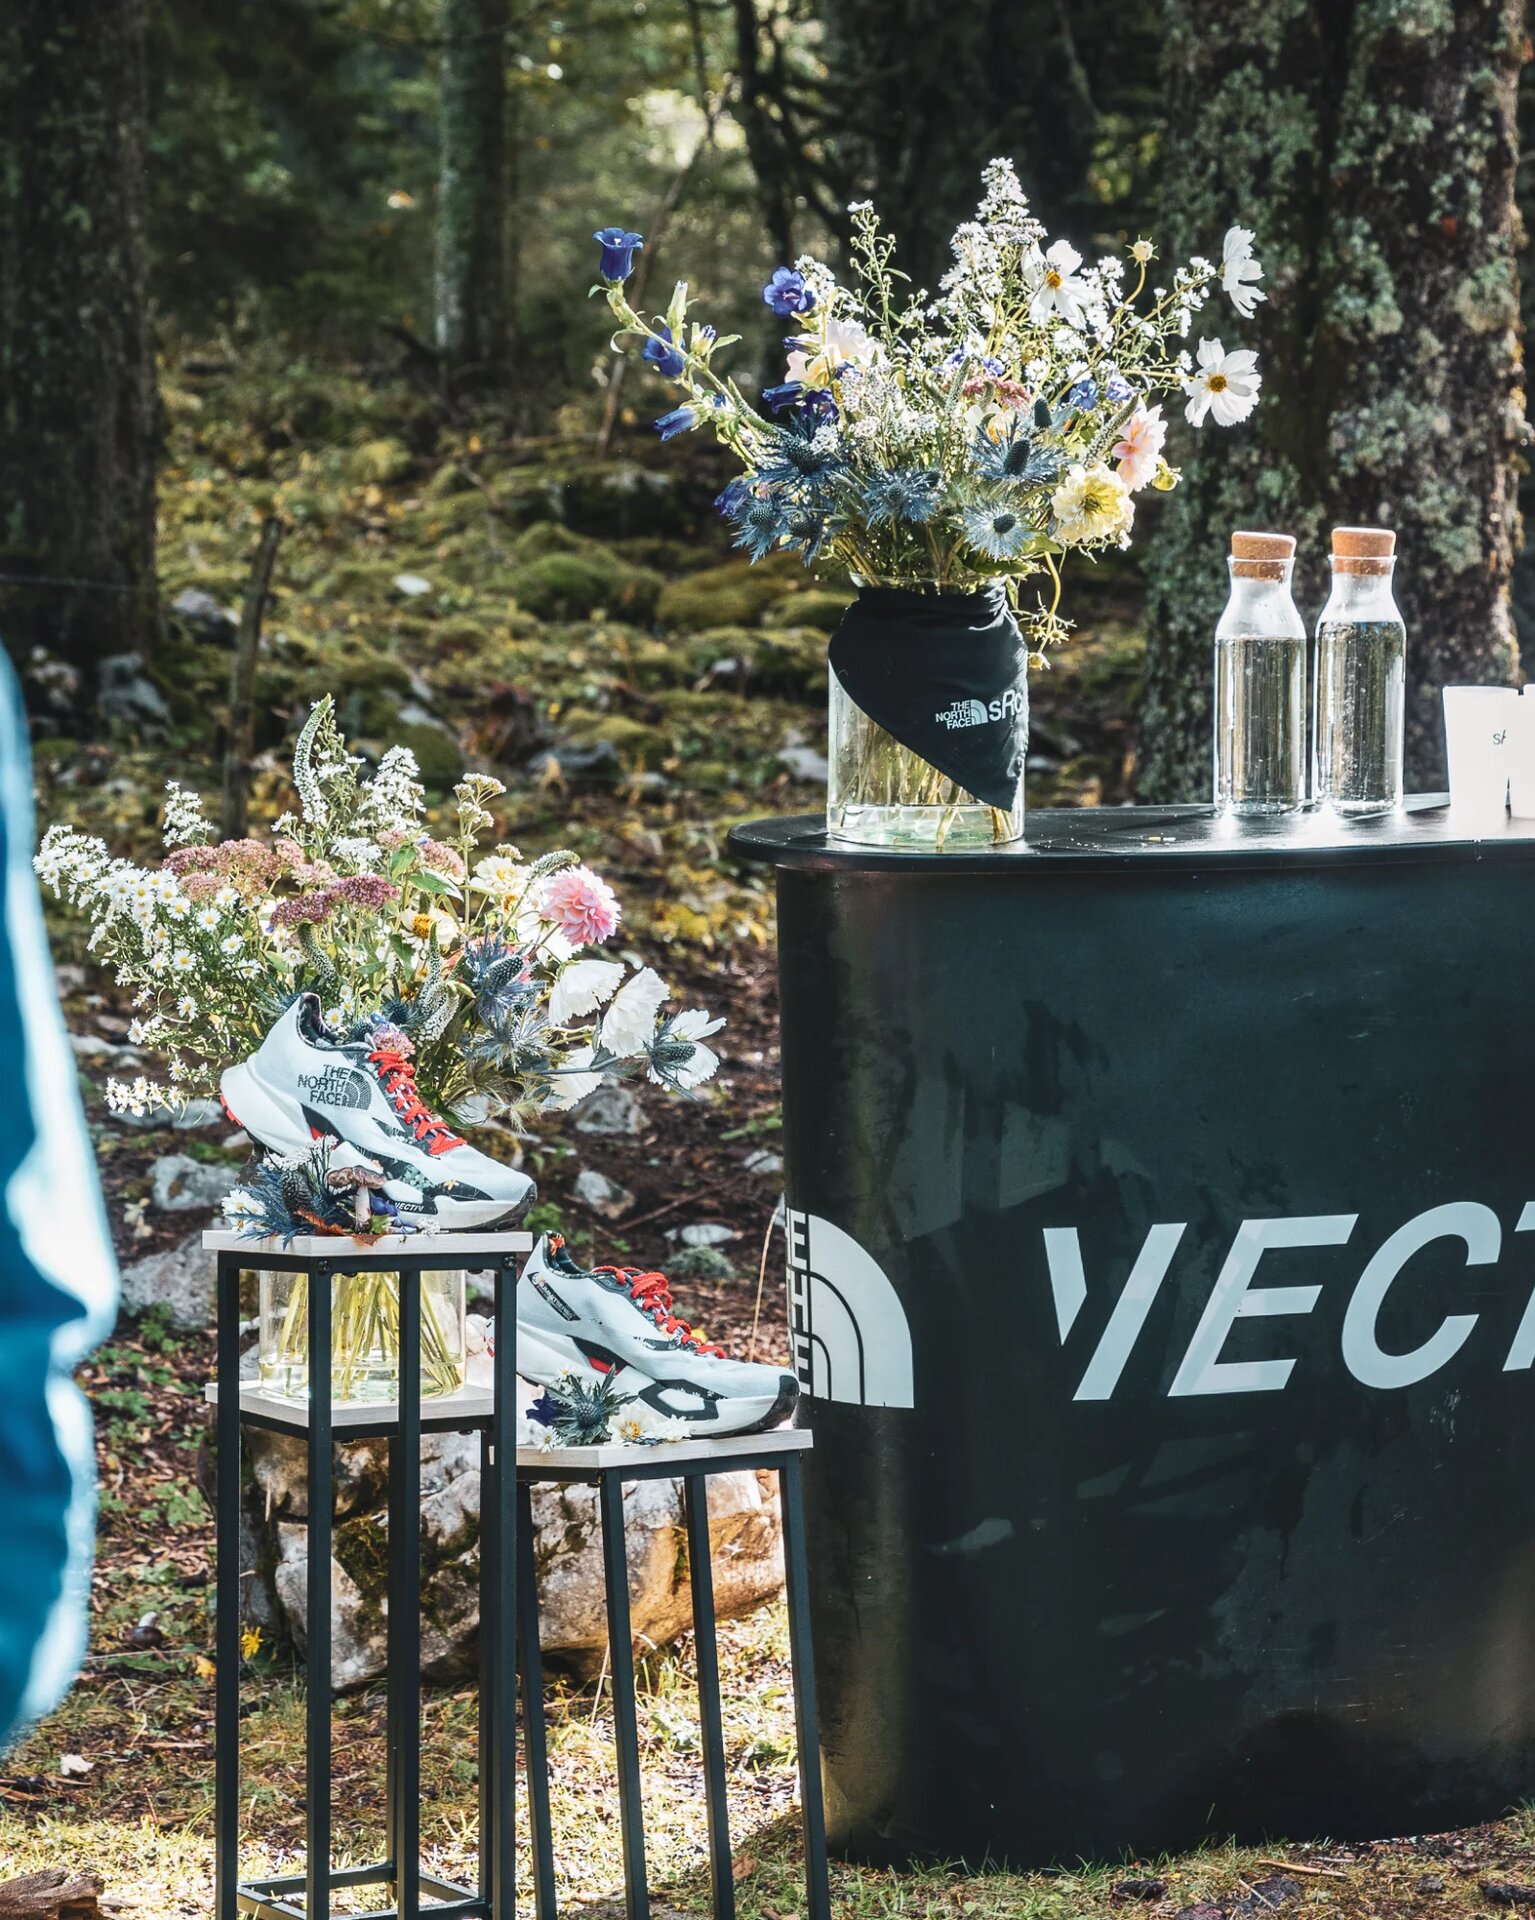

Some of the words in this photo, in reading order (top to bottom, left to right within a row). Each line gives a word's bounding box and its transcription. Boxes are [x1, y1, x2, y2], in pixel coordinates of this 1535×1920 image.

[950, 700, 970, 711] THE
[935, 708, 971, 722] NORTH
[946, 717, 972, 730] FACE
[323, 1064, 351, 1080] THE
[297, 1074, 346, 1093] NORTH
[309, 1090, 343, 1106] FACE
